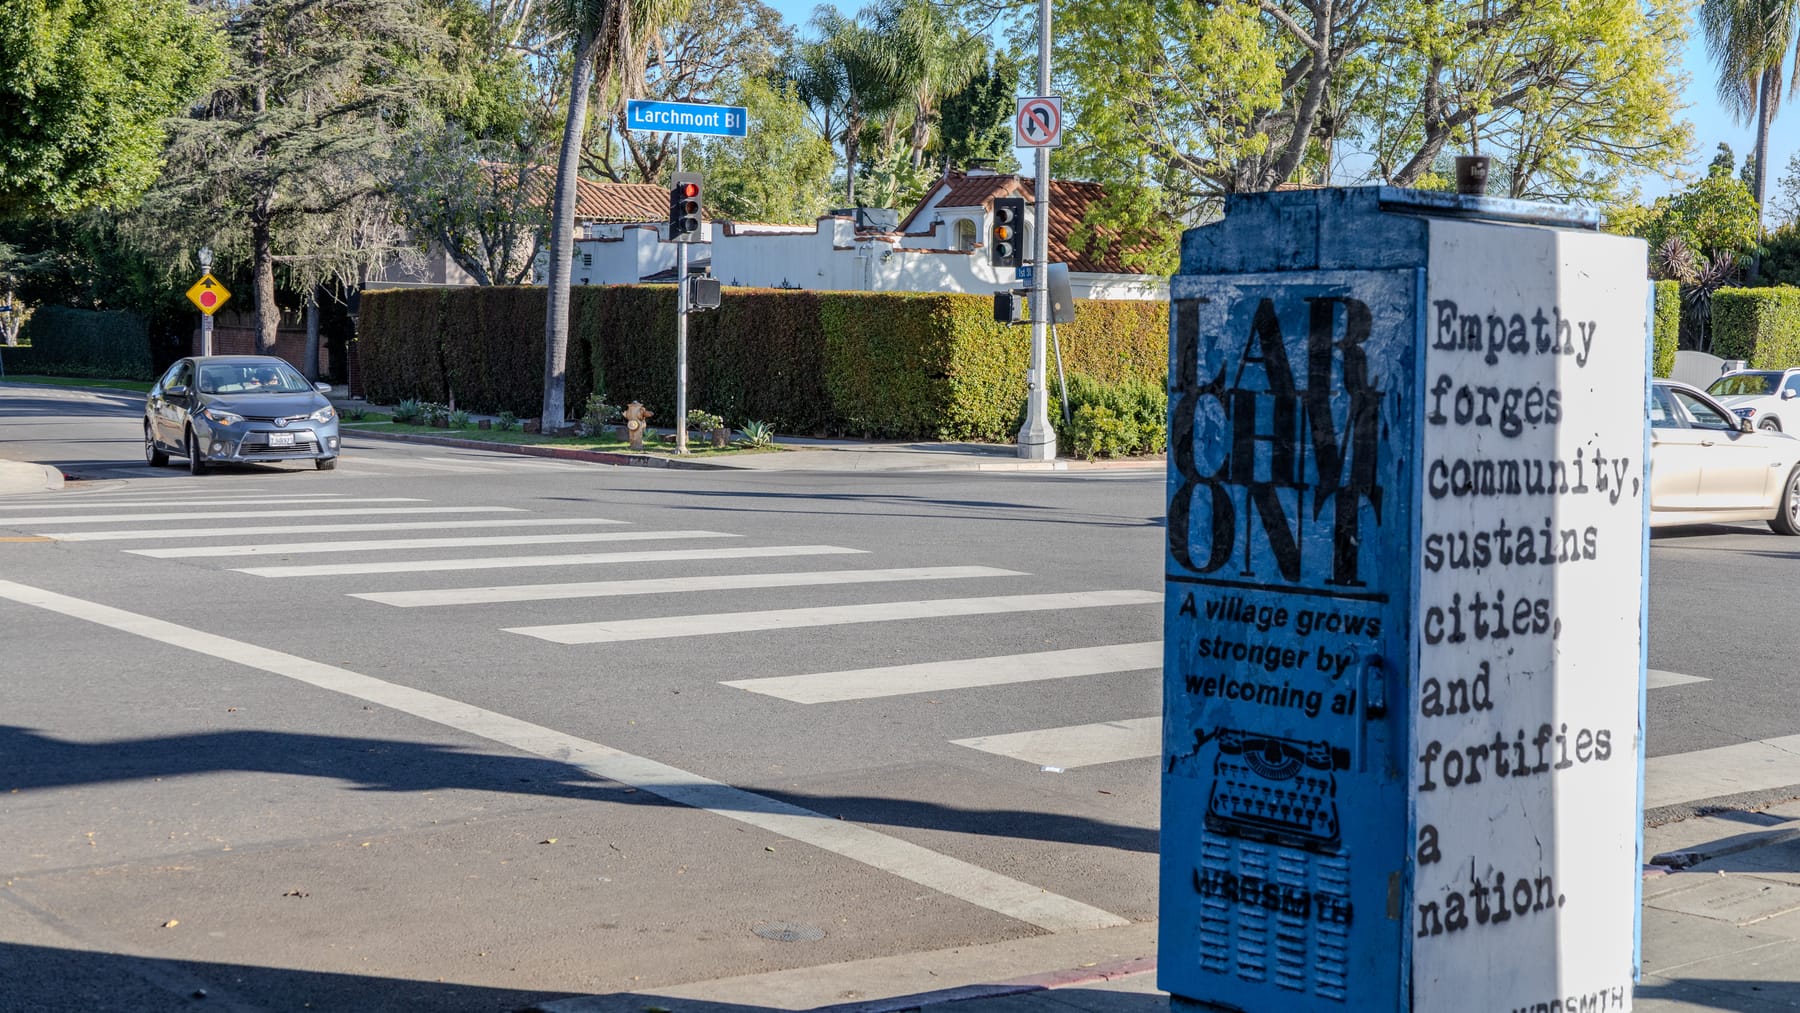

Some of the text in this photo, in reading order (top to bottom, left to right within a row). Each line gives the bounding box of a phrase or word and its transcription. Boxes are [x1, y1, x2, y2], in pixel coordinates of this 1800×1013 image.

[635, 106, 740, 129] Larchmont Bl
[1170, 297, 1386, 399] LAR
[1432, 300, 1597, 367] Empathy
[1429, 374, 1563, 438] forges
[1171, 388, 1383, 492] CHM
[1428, 448, 1640, 506] community,
[1168, 481, 1384, 587] ONT
[1424, 517, 1598, 572] sustains
[1179, 592, 1382, 638] A village grows
[1424, 589, 1562, 645] cities,
[1198, 635, 1351, 680] stronger by
[1184, 673, 1358, 718] welcoming al
[1421, 661, 1494, 718] and
[1418, 723, 1612, 793] fortifies
[1417, 824, 1442, 866] a
[1417, 872, 1567, 938] nation.
